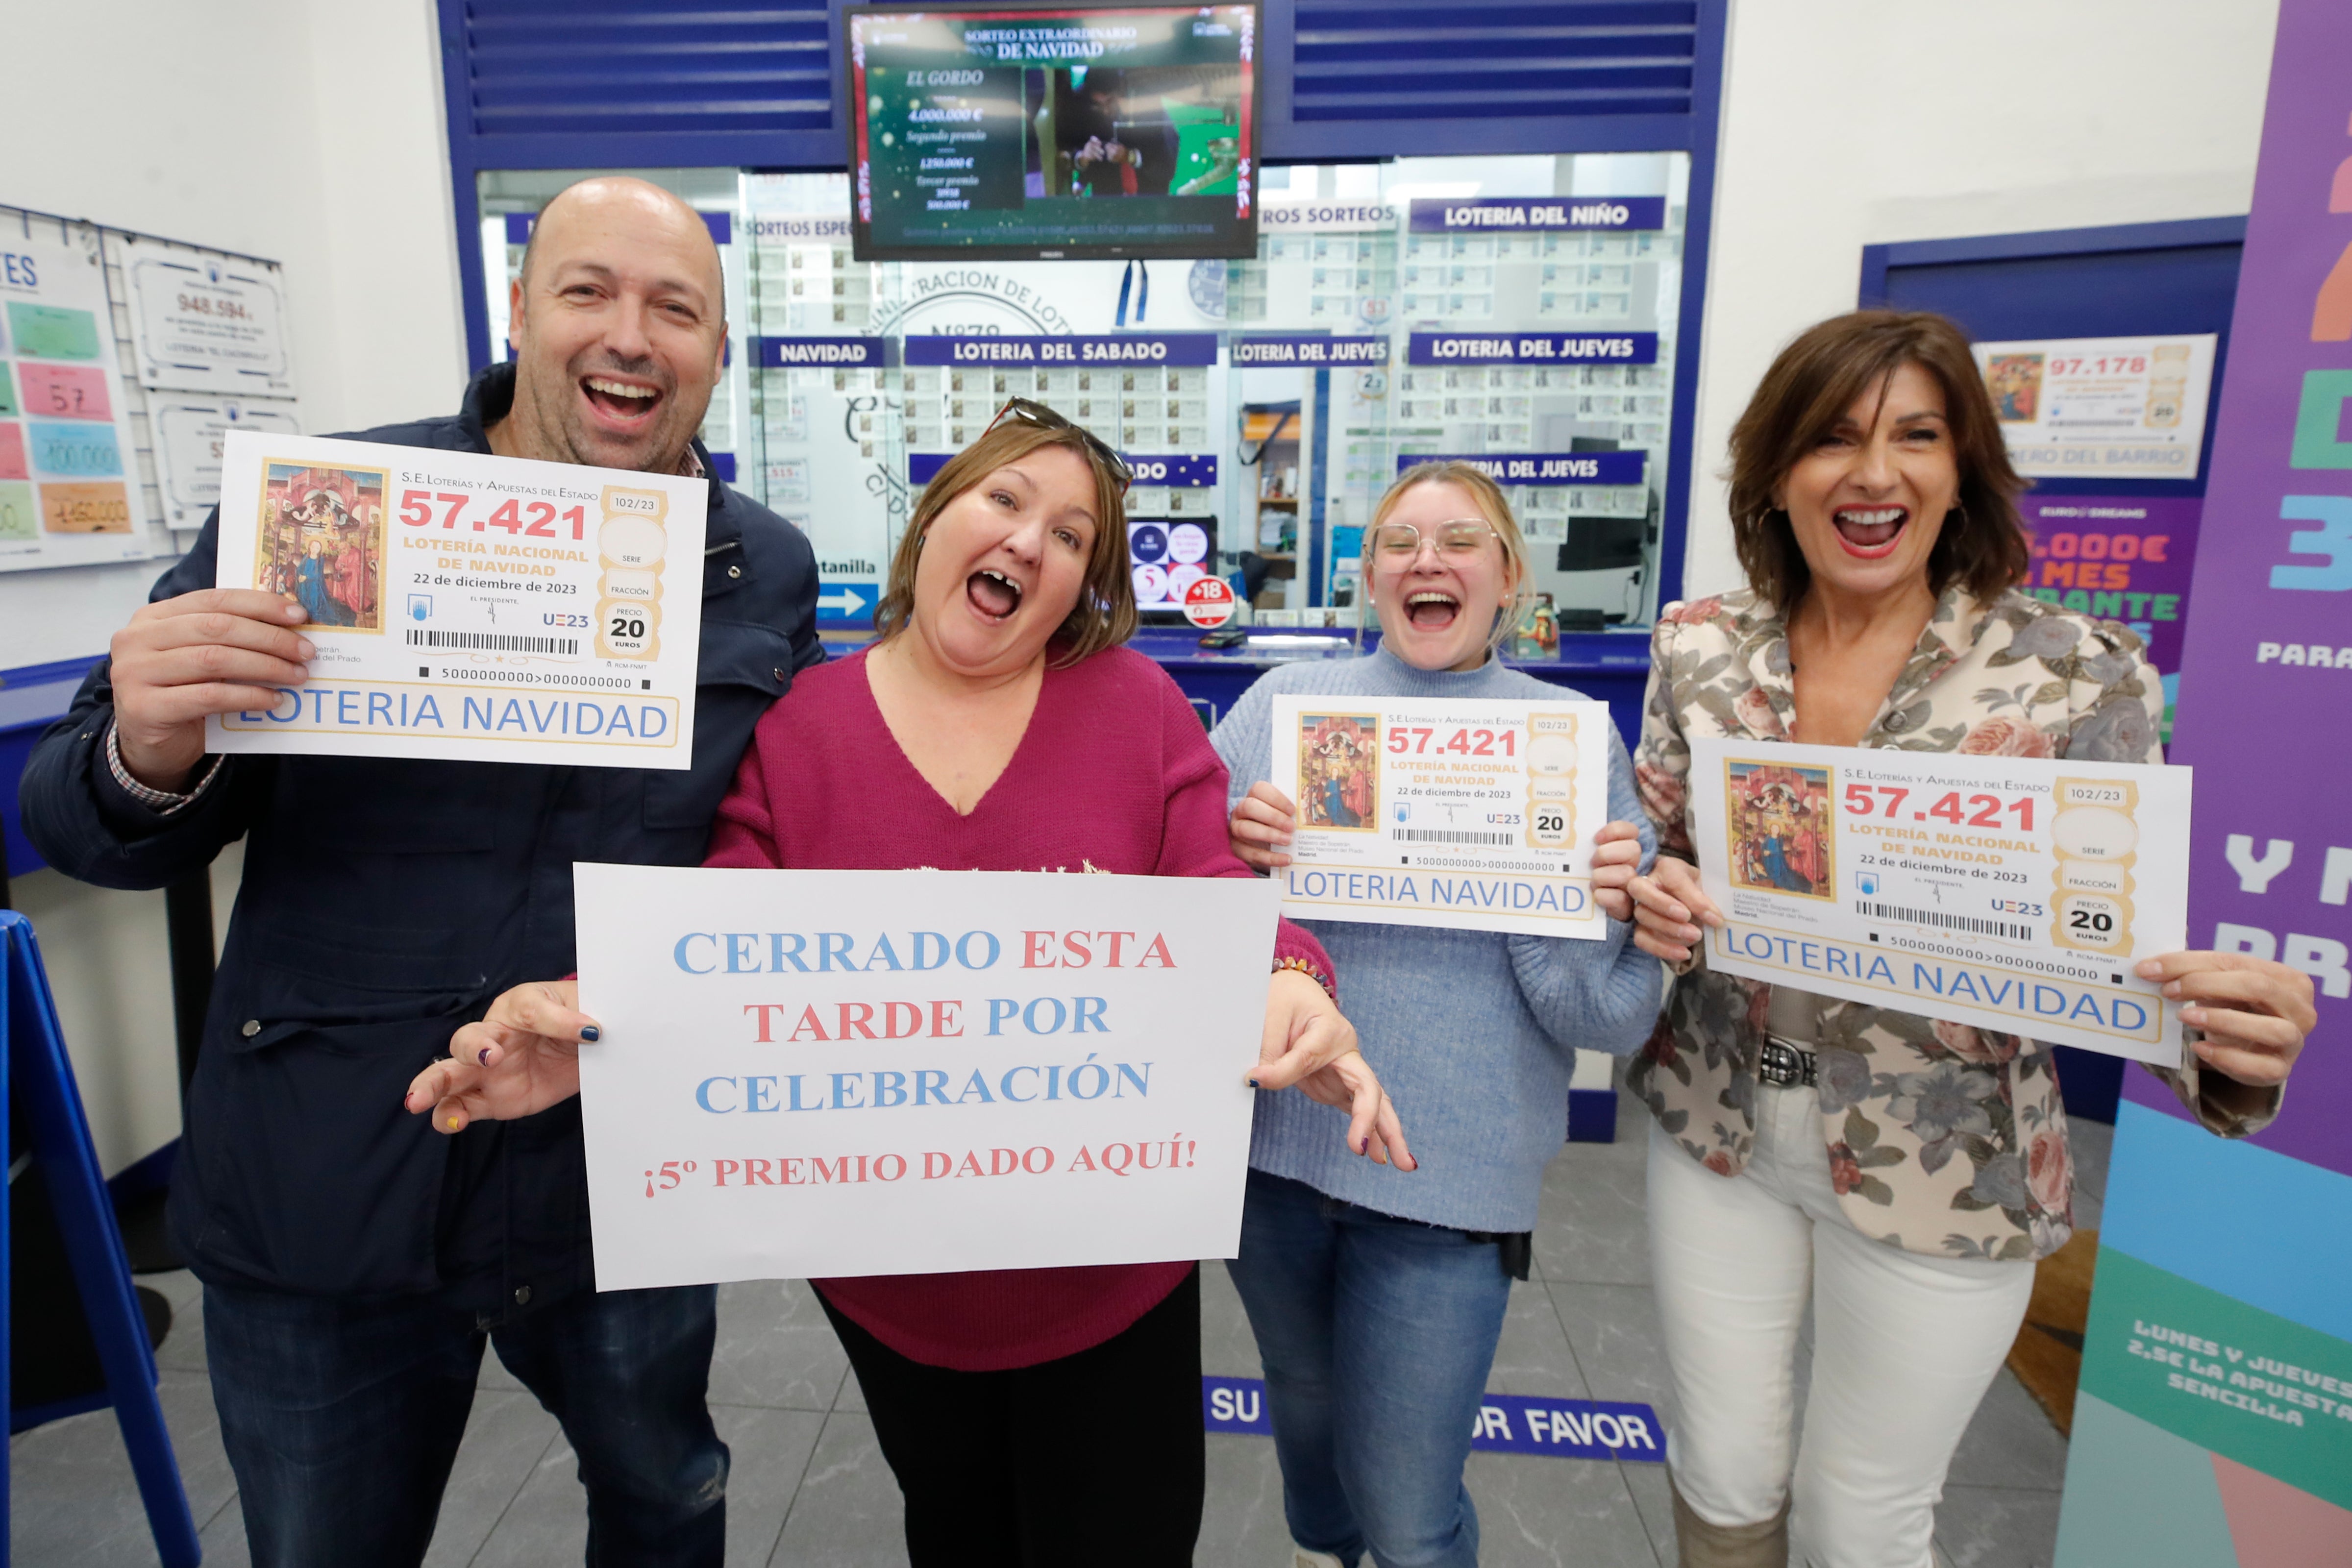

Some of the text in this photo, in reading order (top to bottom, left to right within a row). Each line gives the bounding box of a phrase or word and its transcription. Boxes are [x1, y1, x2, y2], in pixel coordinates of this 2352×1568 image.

[965, 27, 1137, 43] SORTEO EXTRAORDINARIO
[998, 42, 1103, 59] DE NAVIDAD
[906, 70, 984, 87] EL GORDO
[1263, 205, 1394, 223] ROS SORTEOS
[1445, 203, 1629, 226] LOTERIA DEL NIÑO
[746, 221, 809, 235] SORTEOS
[780, 345, 867, 363] NAVIDAD
[955, 343, 1167, 360] LOTERIA DEL SABADO
[1233, 343, 1386, 361] LOTERIA DEL JUEVES
[1432, 338, 1633, 357] LOTERIA DEL JUEVES
[2050, 357, 2146, 376] 97.178
[2064, 448, 2185, 465] DEL BARRIO
[1508, 461, 1537, 478] DEL
[1539, 460, 1598, 478] JUEVES
[427, 474, 473, 489] LOTERÍAS
[487, 481, 537, 494] APUESTAS
[541, 489, 556, 497] DEL
[559, 488, 598, 501] ESTADO
[615, 498, 654, 510] 102/23
[399, 490, 585, 540] 57.421
[403, 537, 589, 563] LOTERÍA NACIONAL
[438, 557, 556, 577] DE NAVIDAD
[821, 559, 875, 573] tanilla
[2042, 561, 2130, 589] MES
[414, 573, 577, 594] 22 de diciembre de 2023
[611, 586, 649, 596] FRACCIÓN
[611, 618, 645, 638] 20
[463, 697, 668, 738] NAVIDAD
[1445, 716, 1480, 725] APUESTAS
[1496, 717, 1525, 726] ESTADO
[1387, 728, 1514, 756] 57.421
[1390, 761, 1519, 773] LOTERÍA NACIONAL
[1435, 776, 1495, 786] NAVIDAD
[1868, 771, 1912, 783] LOTERÍAS
[1927, 775, 1980, 788] APUESTAS
[2005, 781, 2050, 793] ESTADO
[1425, 788, 1471, 798] diciembre
[1488, 790, 1510, 799] 2023
[2071, 789, 2120, 801] 102/23
[1844, 783, 2034, 832] 57.421
[1537, 816, 1563, 831] 20
[1849, 823, 2041, 853] LOTERÍA NACIONAL
[1882, 842, 2004, 865] DE NAVIDAD
[2082, 847, 2105, 856] SERIE
[1860, 854, 2028, 883] 22 de diciembre de 2023
[2225, 833, 2294, 894] Y
[1289, 871, 1585, 912] LOTERIA NAVIDAD
[2069, 878, 2116, 889] FRACCIÓN
[2077, 900, 2109, 910] PRECIO
[2070, 910, 2112, 931] 20
[2076, 933, 2107, 942] EUROS
[673, 930, 1178, 975] CERRADO ESTA
[1727, 928, 2147, 1030] LOTERIA NAVIDAD
[743, 996, 1112, 1044] TARDE POR
[695, 1053, 1155, 1114] CELEBRACIÓN
[711, 1152, 907, 1188] PREMIO
[920, 1146, 1055, 1181] DADO
[1067, 1132, 1197, 1176] AQUÍ!
[2134, 1320, 2352, 1399] LUNES Y JUEVES
[2189, 1357, 2224, 1381] LA
[2229, 1372, 2352, 1421] APUESTA
[1211, 1389, 1260, 1422] SU
[2168, 1373, 2303, 1427] SENCILLA
[1524, 1408, 1657, 1450] FAVOR
